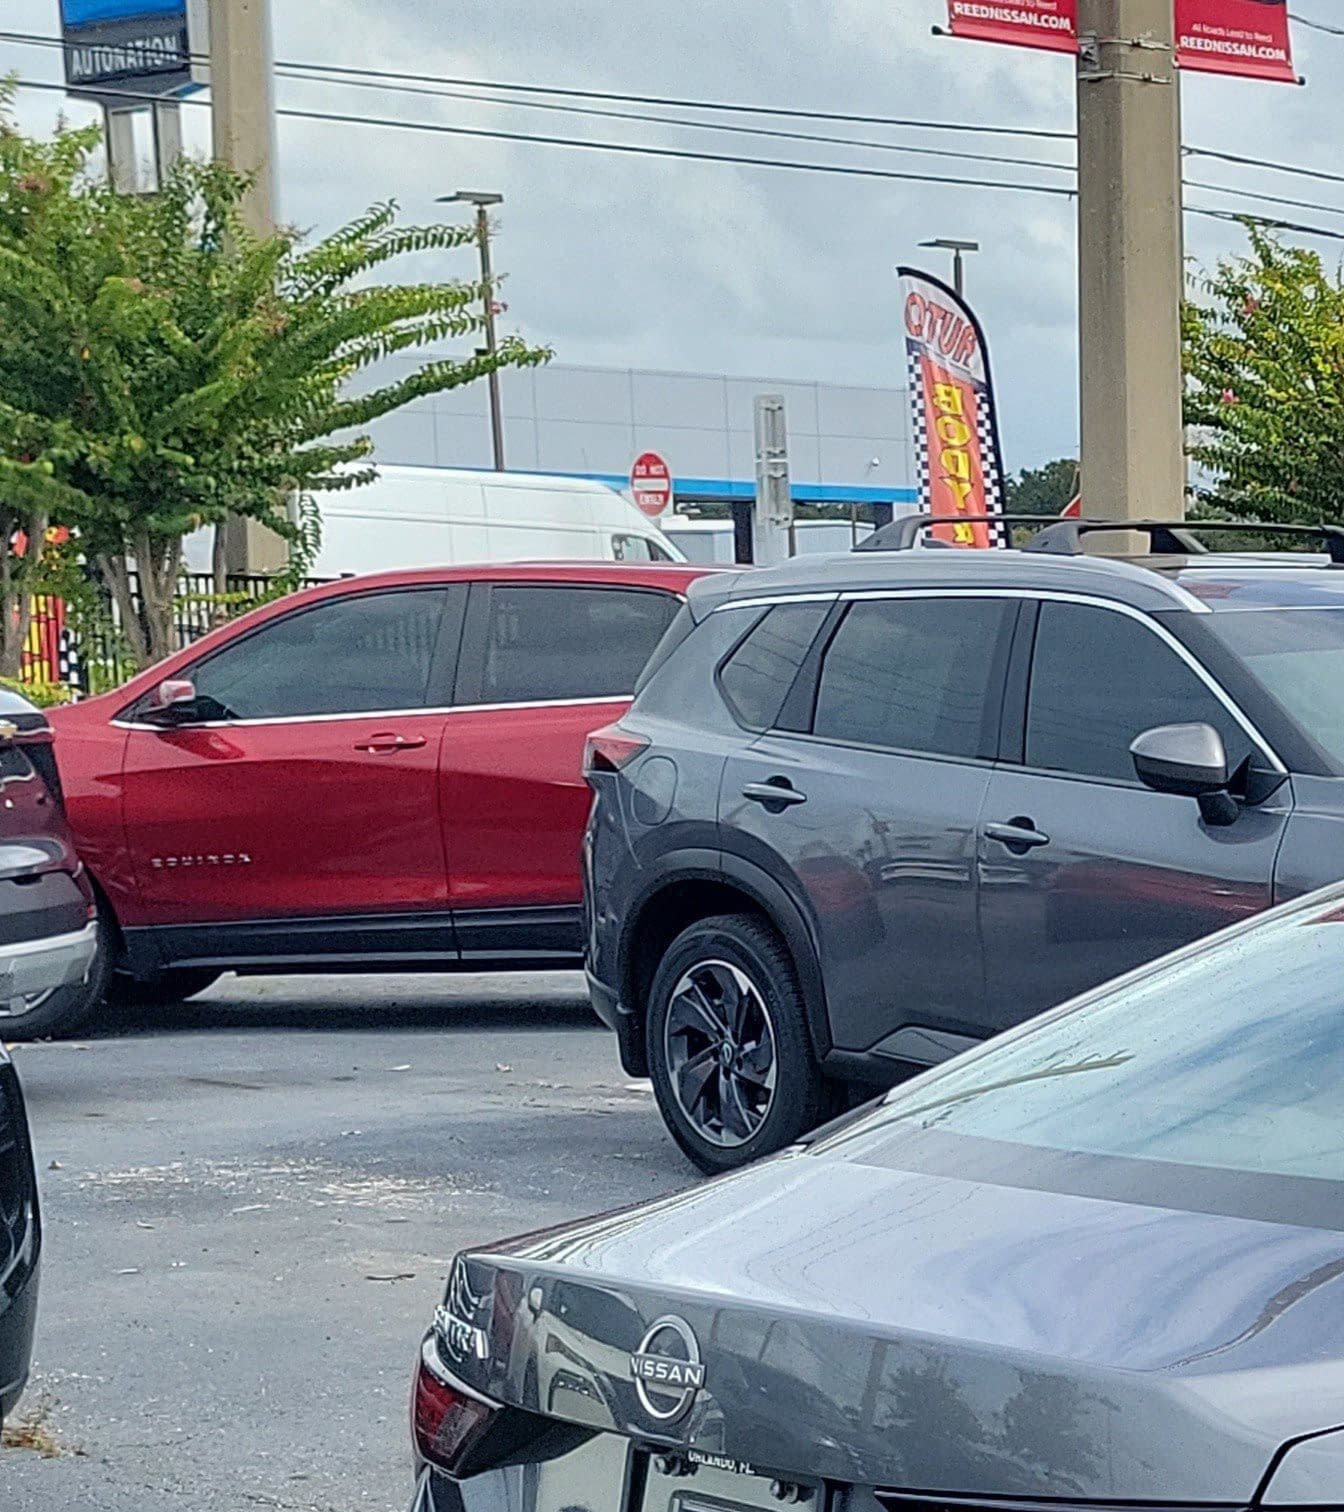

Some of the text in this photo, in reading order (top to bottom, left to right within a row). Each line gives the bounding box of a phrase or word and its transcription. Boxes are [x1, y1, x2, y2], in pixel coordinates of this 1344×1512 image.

[953, 2, 1072, 30] REEDNISSAN.COM
[71, 36, 178, 76] AUTONATION
[1180, 35, 1287, 60] REEDNISSAN.COM
[151, 853, 252, 868] EQUINOX
[630, 1356, 702, 1385] NISSAN
